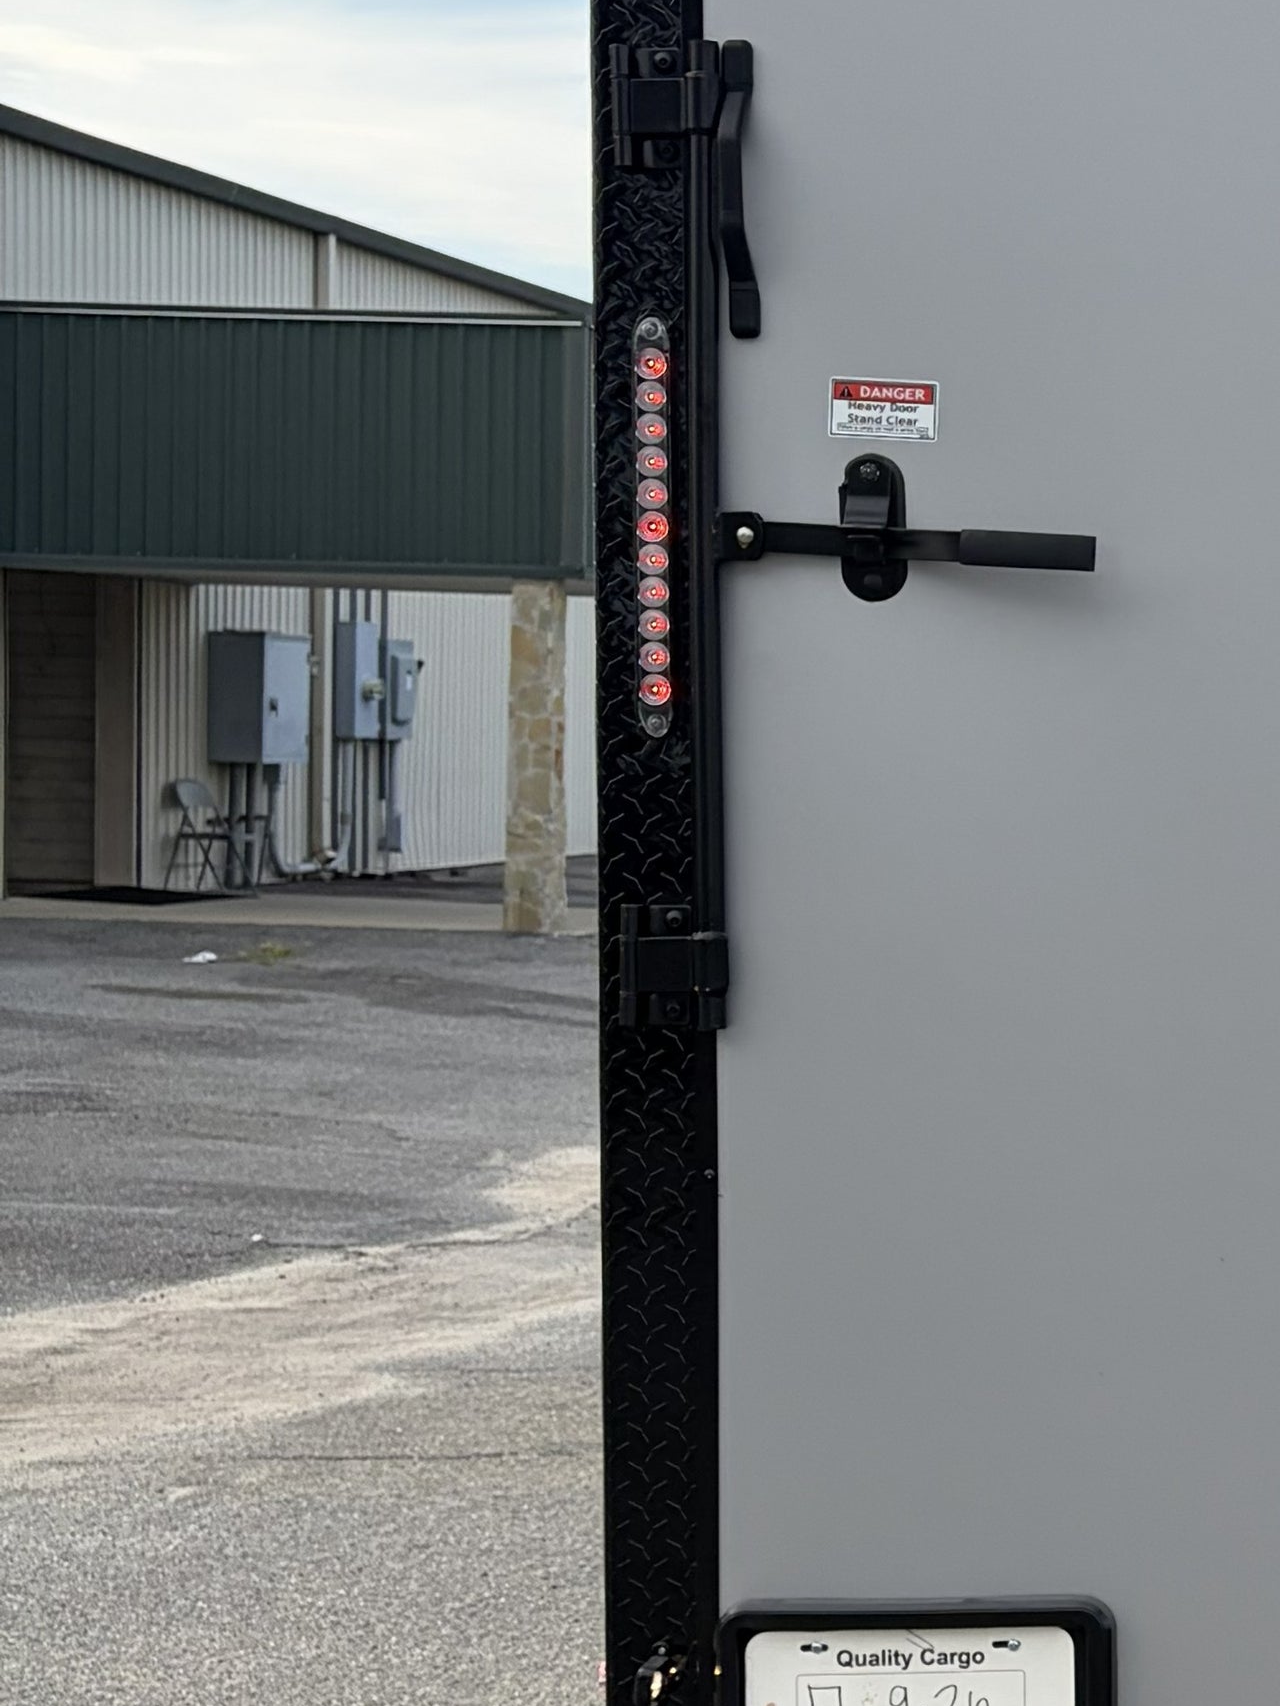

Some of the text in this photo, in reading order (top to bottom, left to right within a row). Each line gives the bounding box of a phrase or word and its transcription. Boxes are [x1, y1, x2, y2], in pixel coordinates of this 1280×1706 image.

[860, 385, 925, 401] DANGER
[848, 401, 919, 413] Heavy Door
[848, 413, 919, 426] Stand Clear
[836, 1648, 985, 1670] Quality Cargo
